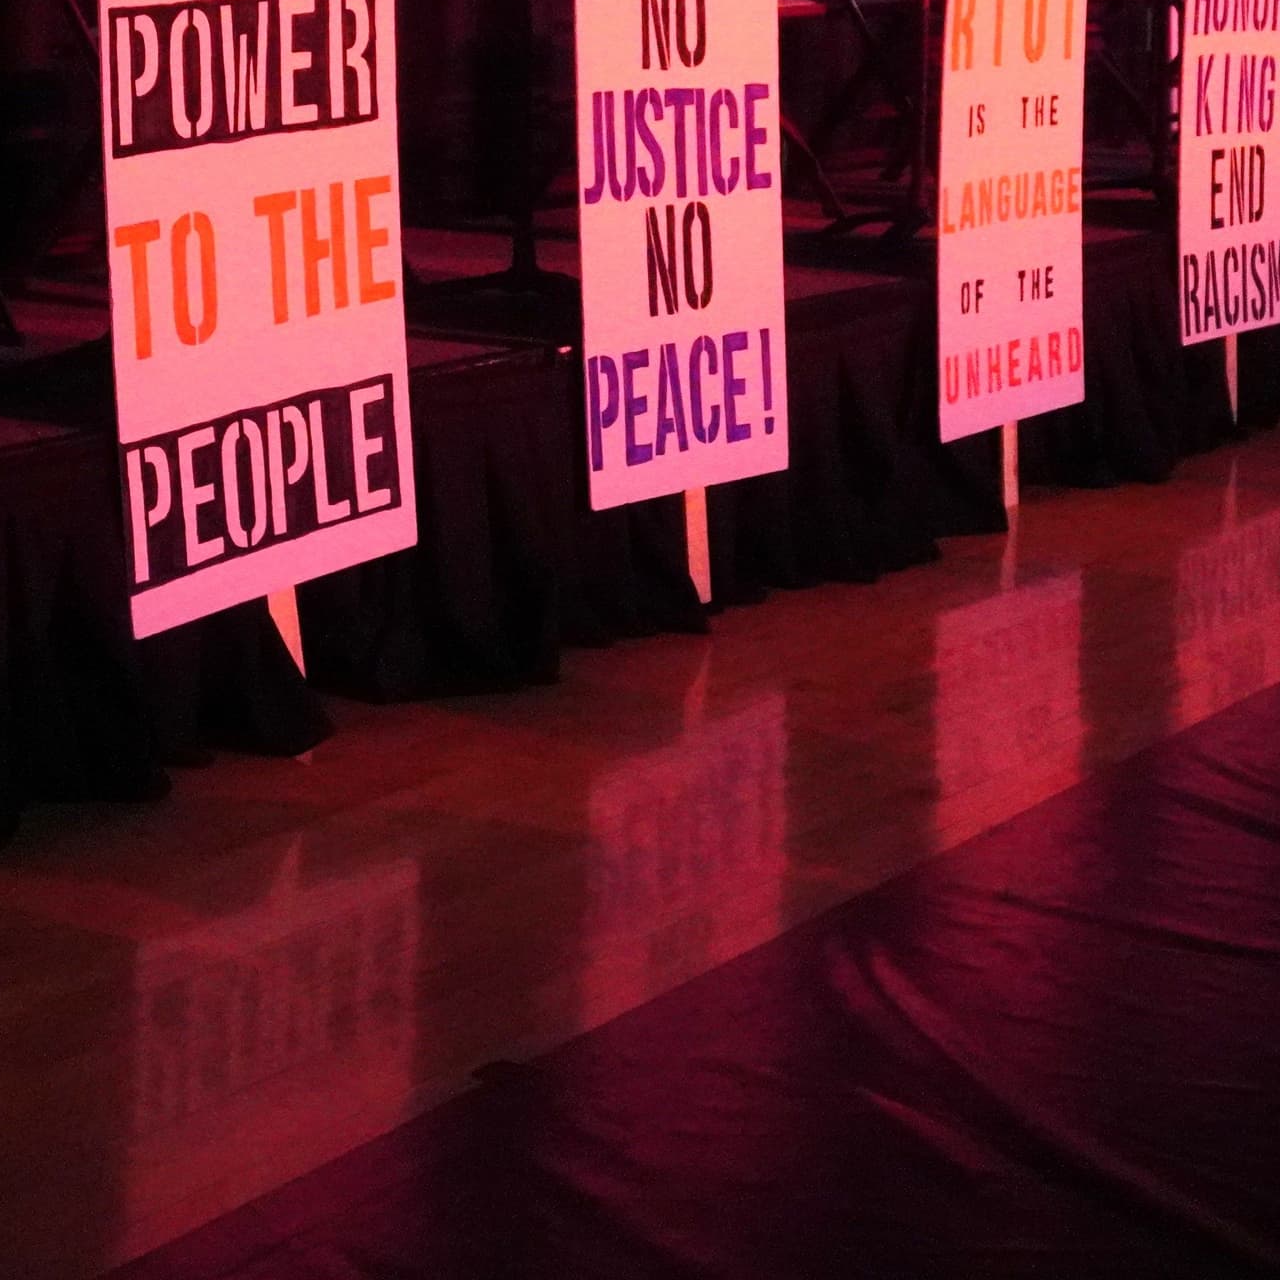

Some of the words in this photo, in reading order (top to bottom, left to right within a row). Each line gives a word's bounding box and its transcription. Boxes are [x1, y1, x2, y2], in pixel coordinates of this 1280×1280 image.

[969, 104, 985, 137] IS
[1021, 96, 1058, 128] THE
[1196, 53, 1275, 136] KING
[584, 85, 771, 203] JUSTICE
[942, 168, 1079, 233] LANGUAGE
[1210, 145, 1264, 229] END
[114, 210, 219, 361] TO
[252, 174, 397, 325] THE
[646, 202, 712, 316] NO
[961, 280, 984, 313] OF
[1018, 267, 1053, 301] THE
[587, 329, 774, 471] PEACE!
[945, 328, 1081, 403] UNHEARD
[126, 382, 392, 585] PEOPLE
